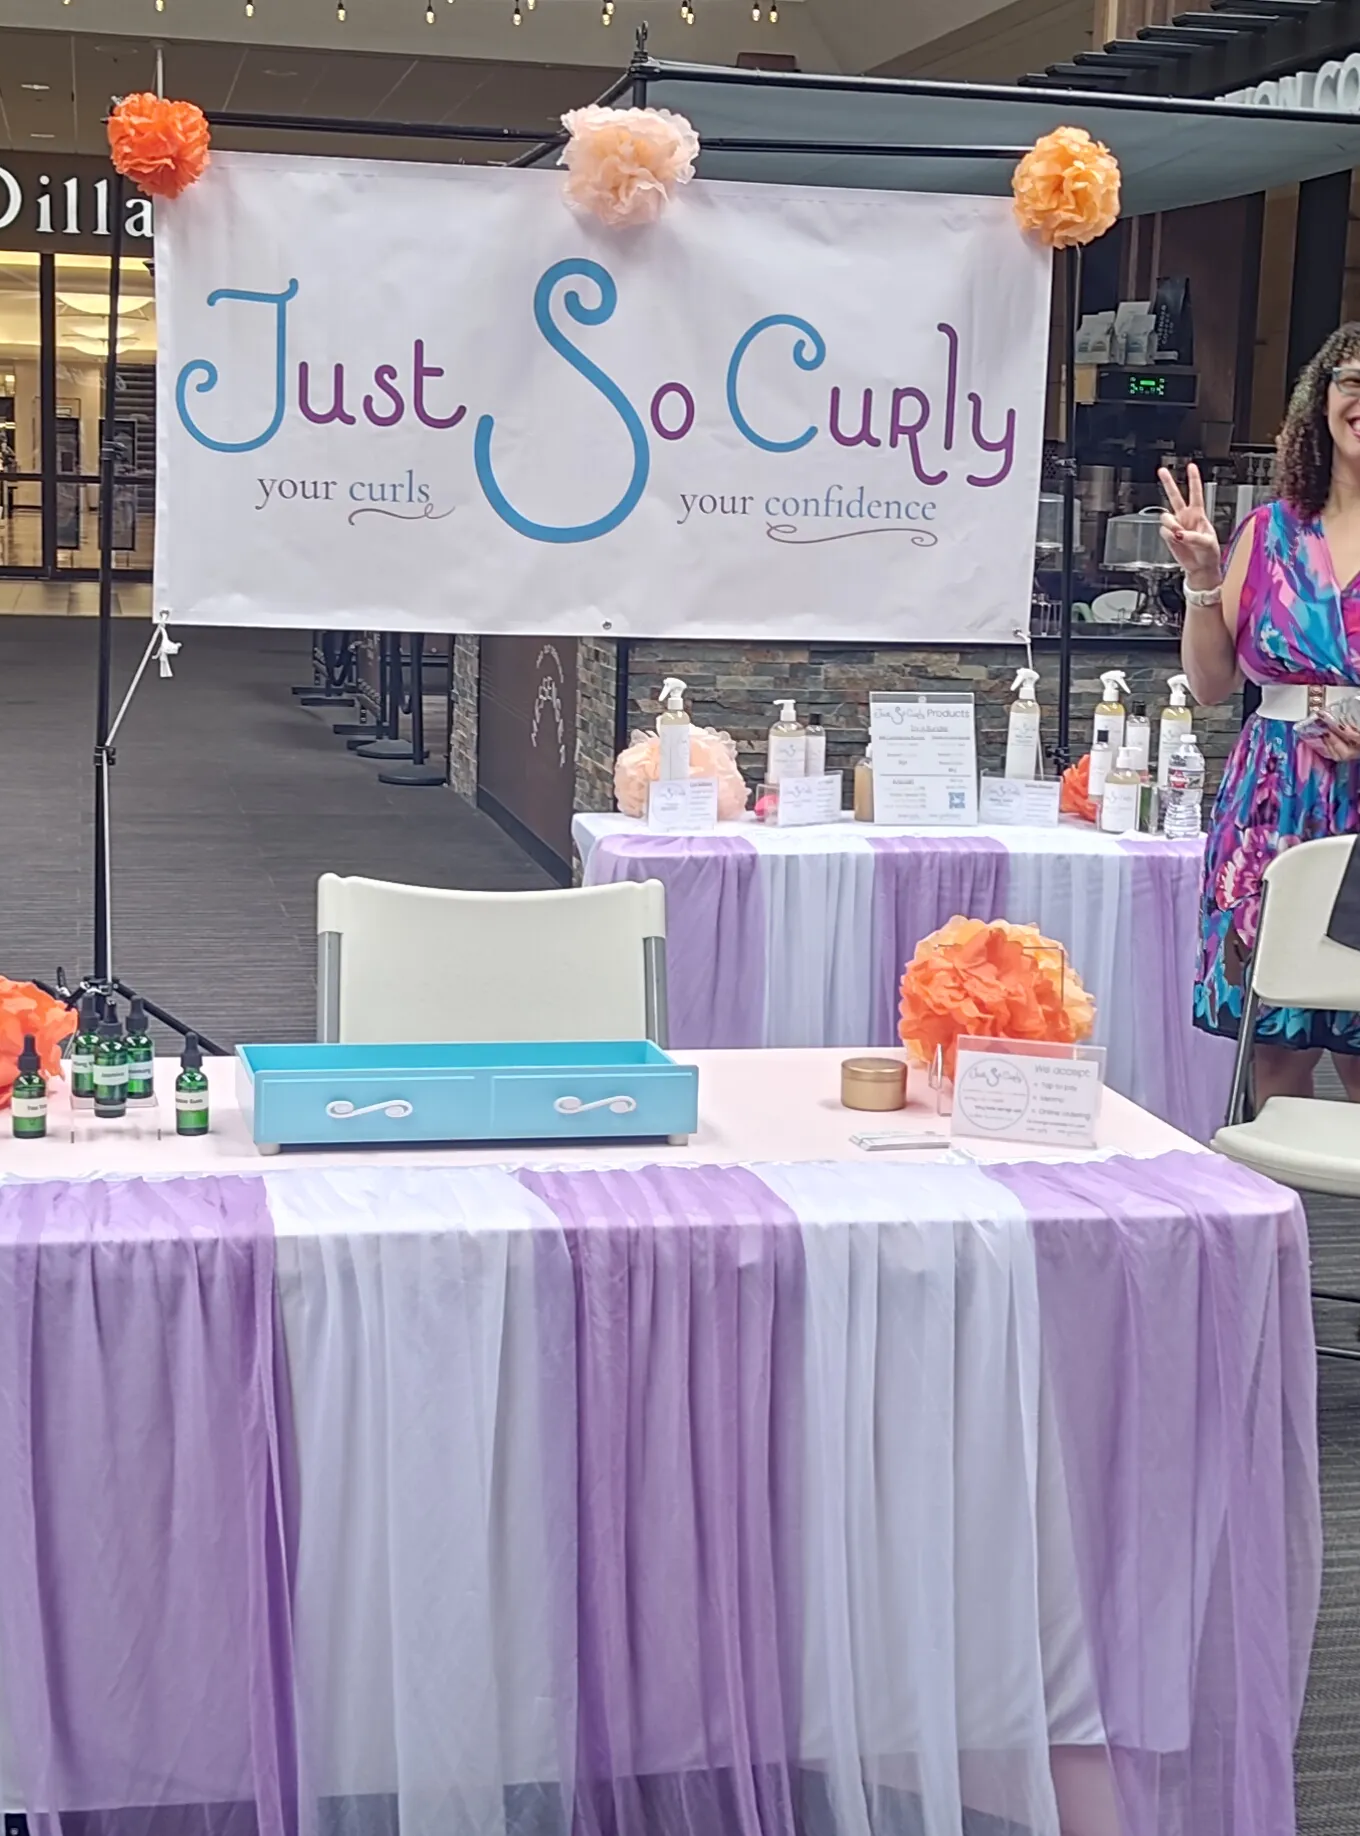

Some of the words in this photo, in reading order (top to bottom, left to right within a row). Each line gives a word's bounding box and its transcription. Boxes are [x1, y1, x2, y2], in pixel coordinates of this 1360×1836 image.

[175, 278, 467, 453] Just
[473, 257, 695, 543] So
[727, 314, 1016, 487] Curly
[255, 472, 338, 510] your
[349, 469, 430, 505] curls
[676, 489, 755, 526] your
[764, 484, 938, 522] confidence
[927, 708, 970, 718] Products
